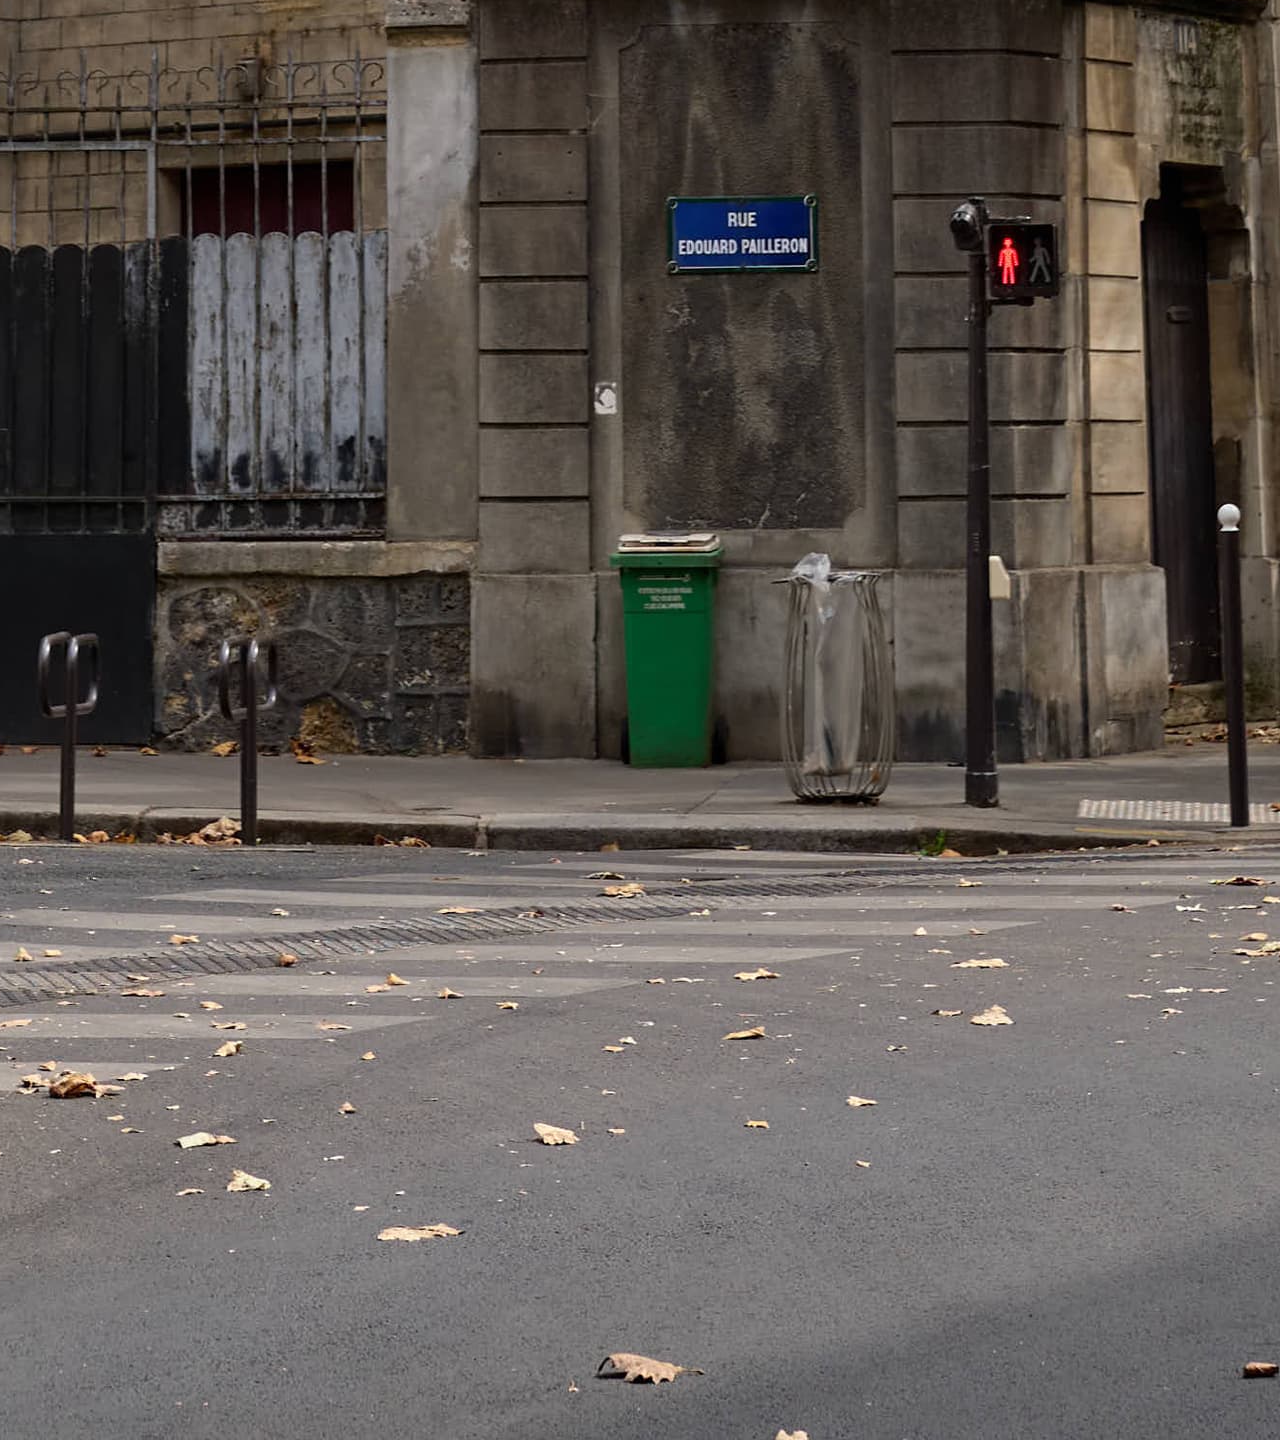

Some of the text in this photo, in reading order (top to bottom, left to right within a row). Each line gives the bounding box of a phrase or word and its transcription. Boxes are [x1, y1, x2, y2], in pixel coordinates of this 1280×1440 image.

[727, 211, 757, 227] RUE
[678, 237, 808, 255] EDOUARD PAILLERON
